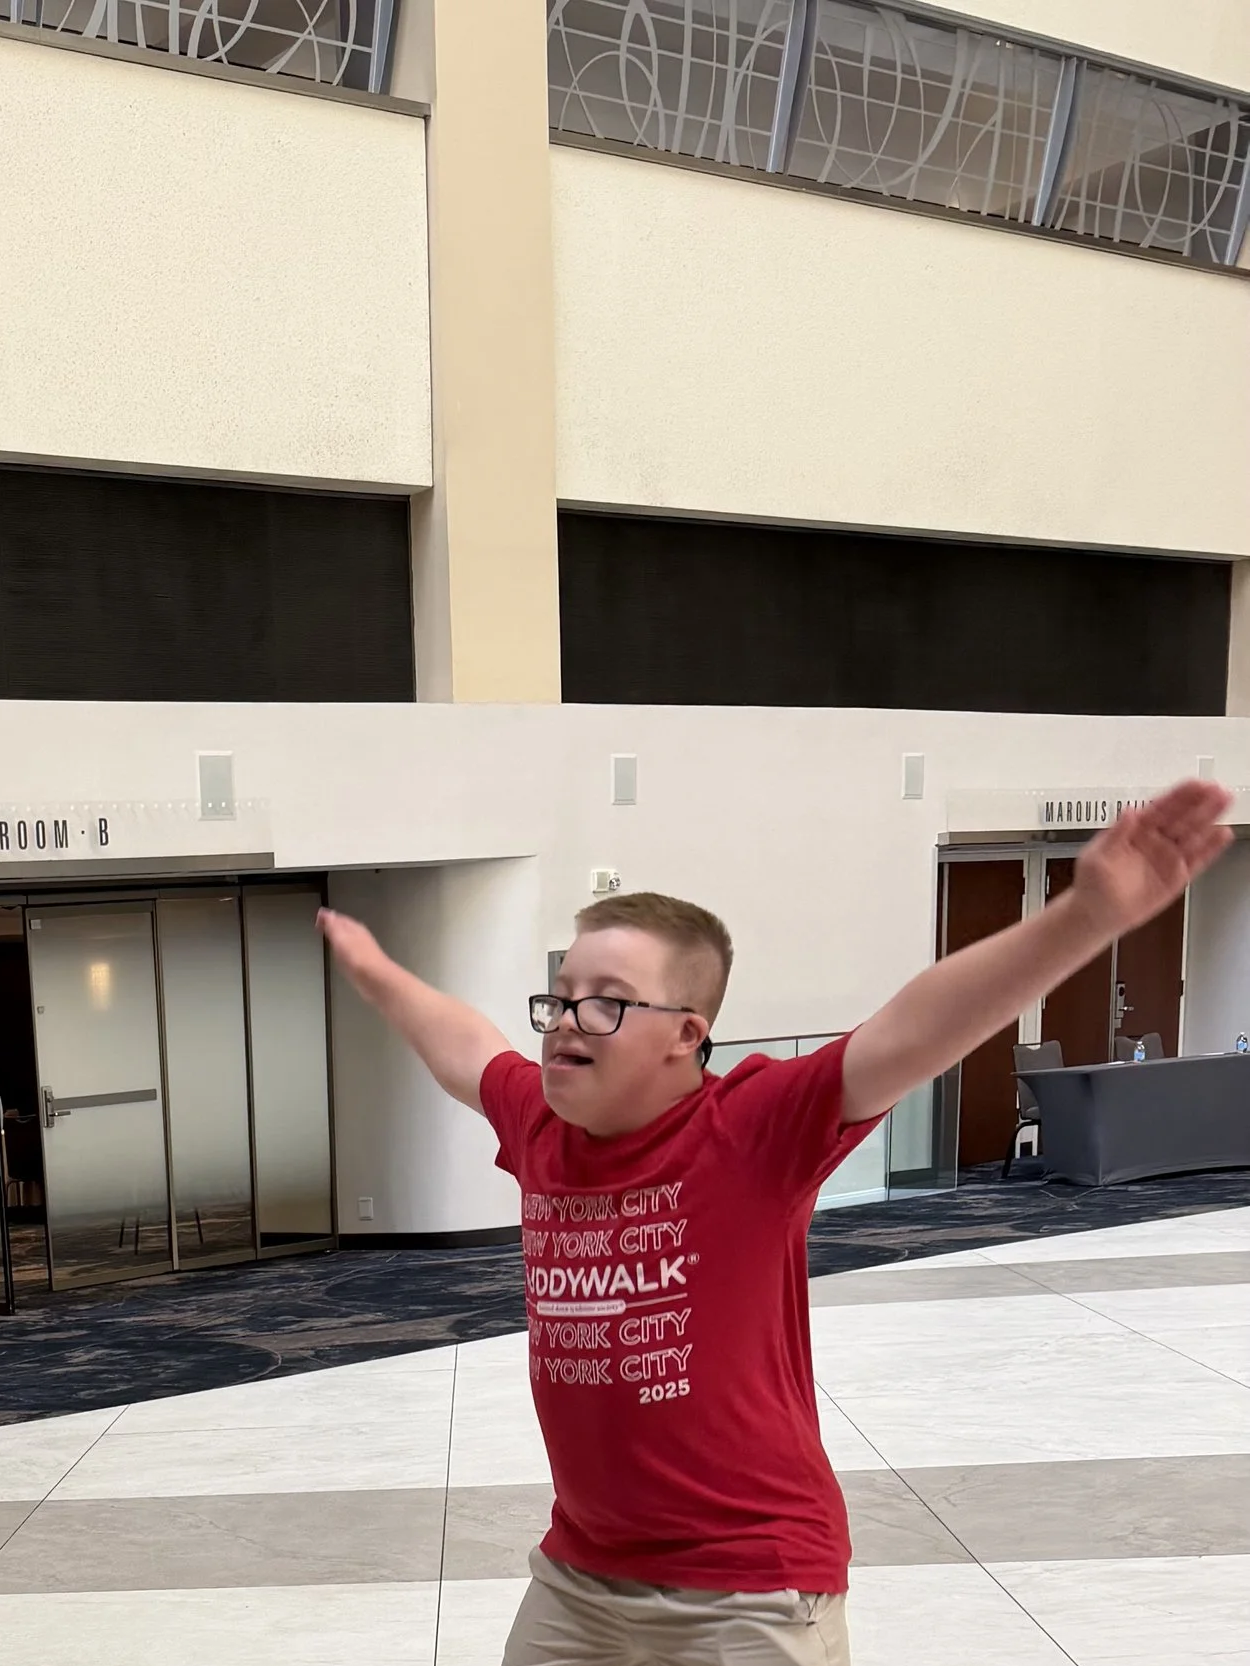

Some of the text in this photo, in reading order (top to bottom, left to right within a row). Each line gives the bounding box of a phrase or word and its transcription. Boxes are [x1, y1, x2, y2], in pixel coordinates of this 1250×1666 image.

[1045, 800, 1107, 822] MARQUIS
[98, 817, 110, 847] B
[552, 1194, 617, 1223] YORK
[620, 1181, 683, 1218] CITY
[552, 1229, 613, 1259] YORK
[619, 1219, 688, 1255] CITY
[545, 1321, 612, 1349] YORK
[619, 1308, 692, 1346] CITY
[544, 1358, 614, 1385] YORK
[619, 1344, 694, 1383] CITY
[639, 1378, 691, 1405] 2025
